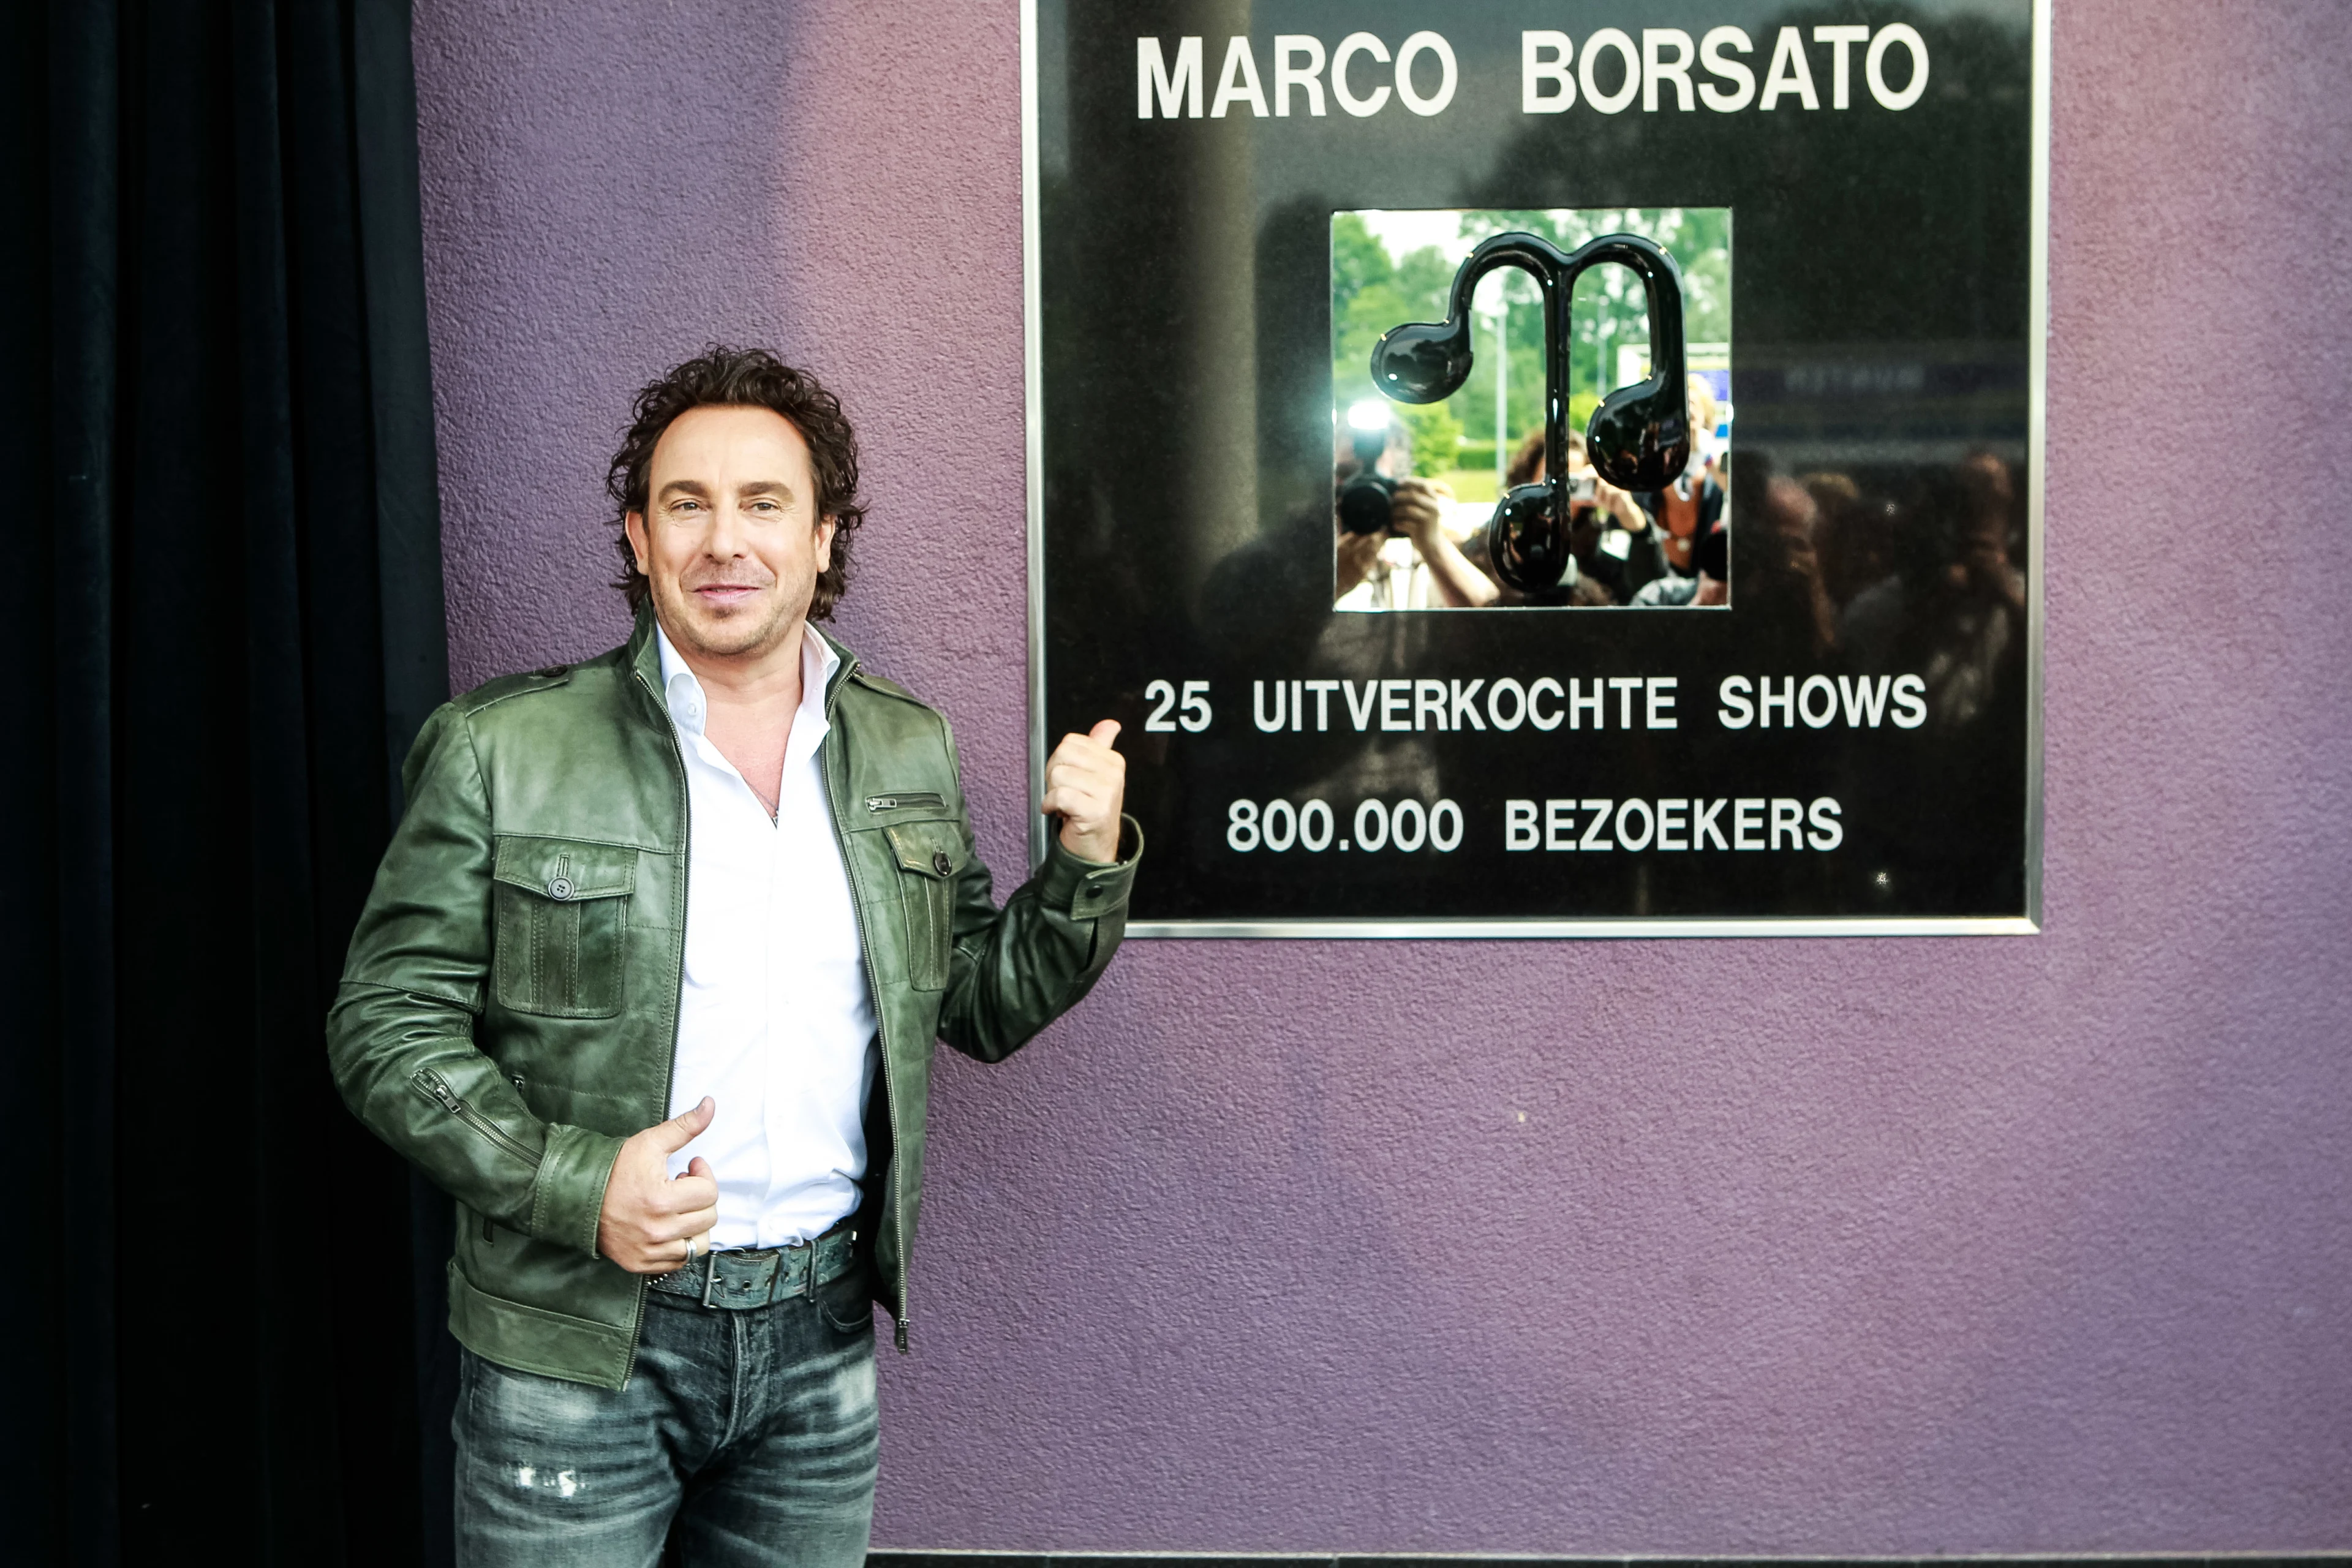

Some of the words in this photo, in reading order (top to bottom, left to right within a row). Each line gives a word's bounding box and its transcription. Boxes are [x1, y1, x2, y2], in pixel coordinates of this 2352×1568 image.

[1137, 30, 1458, 119] MARCO
[1521, 23, 1929, 115] BORSATO
[1145, 680, 1212, 733] 25
[1253, 677, 1678, 733] UITVERKOCHTE
[1718, 674, 1928, 729] SHOWS
[1227, 799, 1464, 851] 800.000
[1506, 797, 1843, 851] BEZOEKERS
